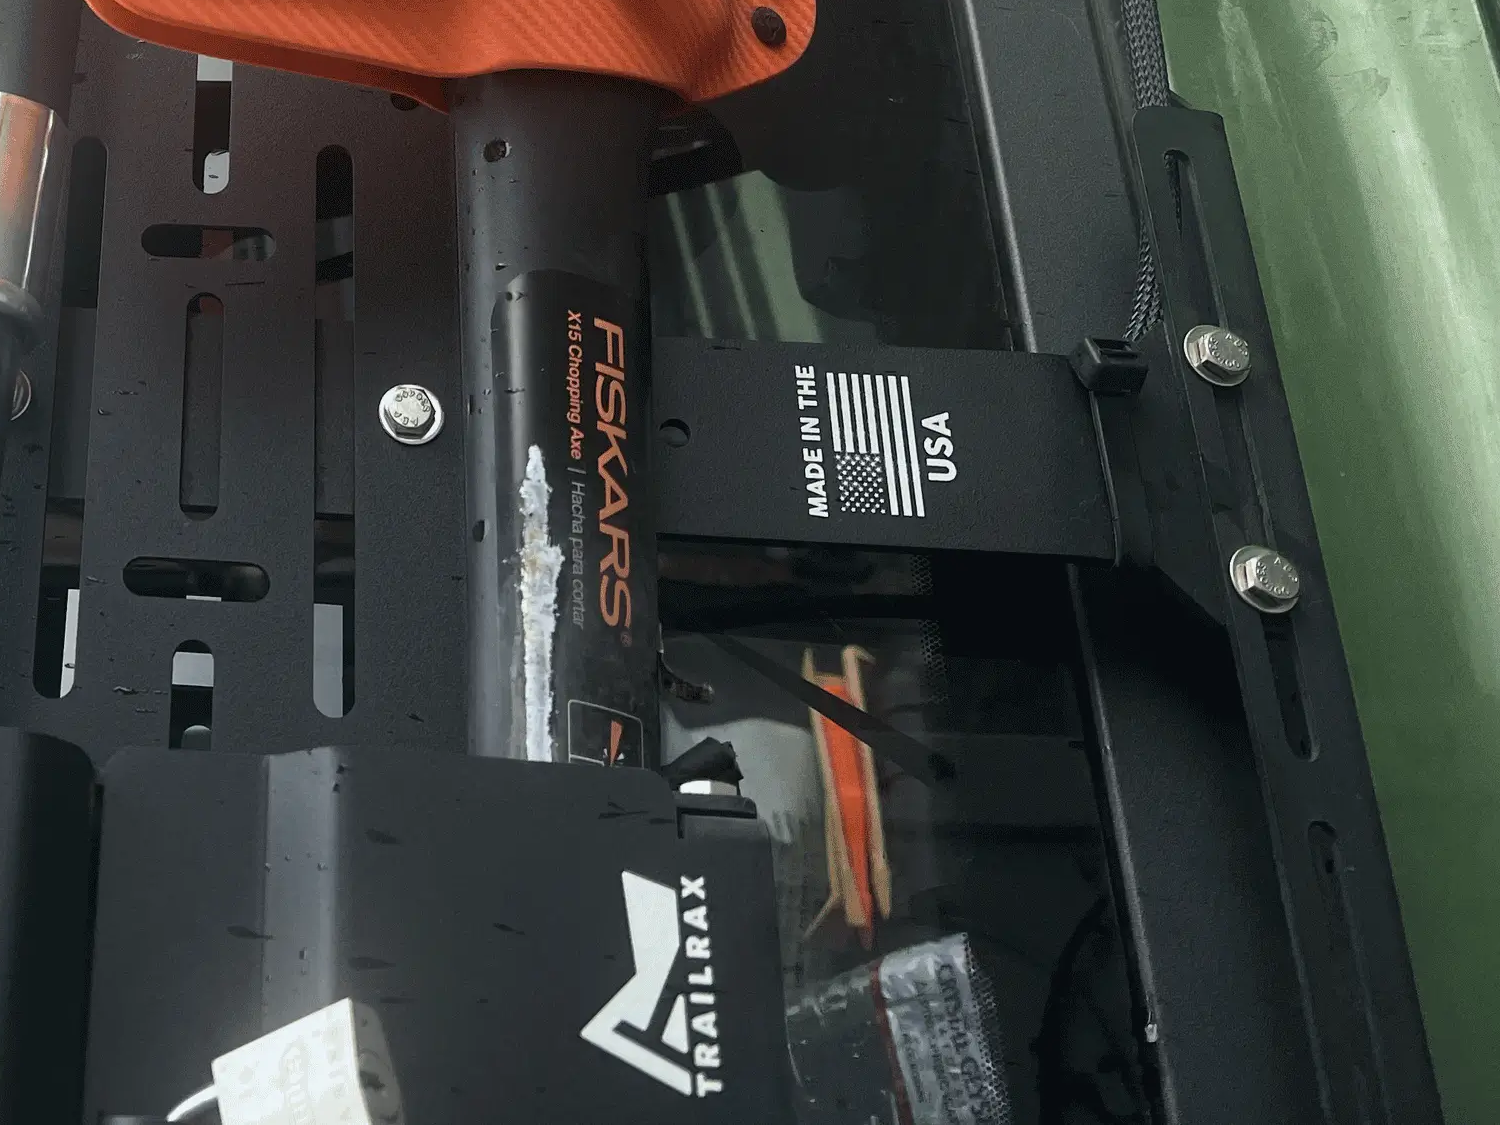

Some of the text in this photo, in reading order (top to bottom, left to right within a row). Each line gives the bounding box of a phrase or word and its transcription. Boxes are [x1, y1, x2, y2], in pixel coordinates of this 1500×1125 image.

[566, 309, 586, 631] X15 Chopping Axe Hacha para cortar
[794, 365, 829, 518] MADE IN THE
[921, 412, 958, 482] USA
[680, 875, 724, 1098] TRAILRAX
